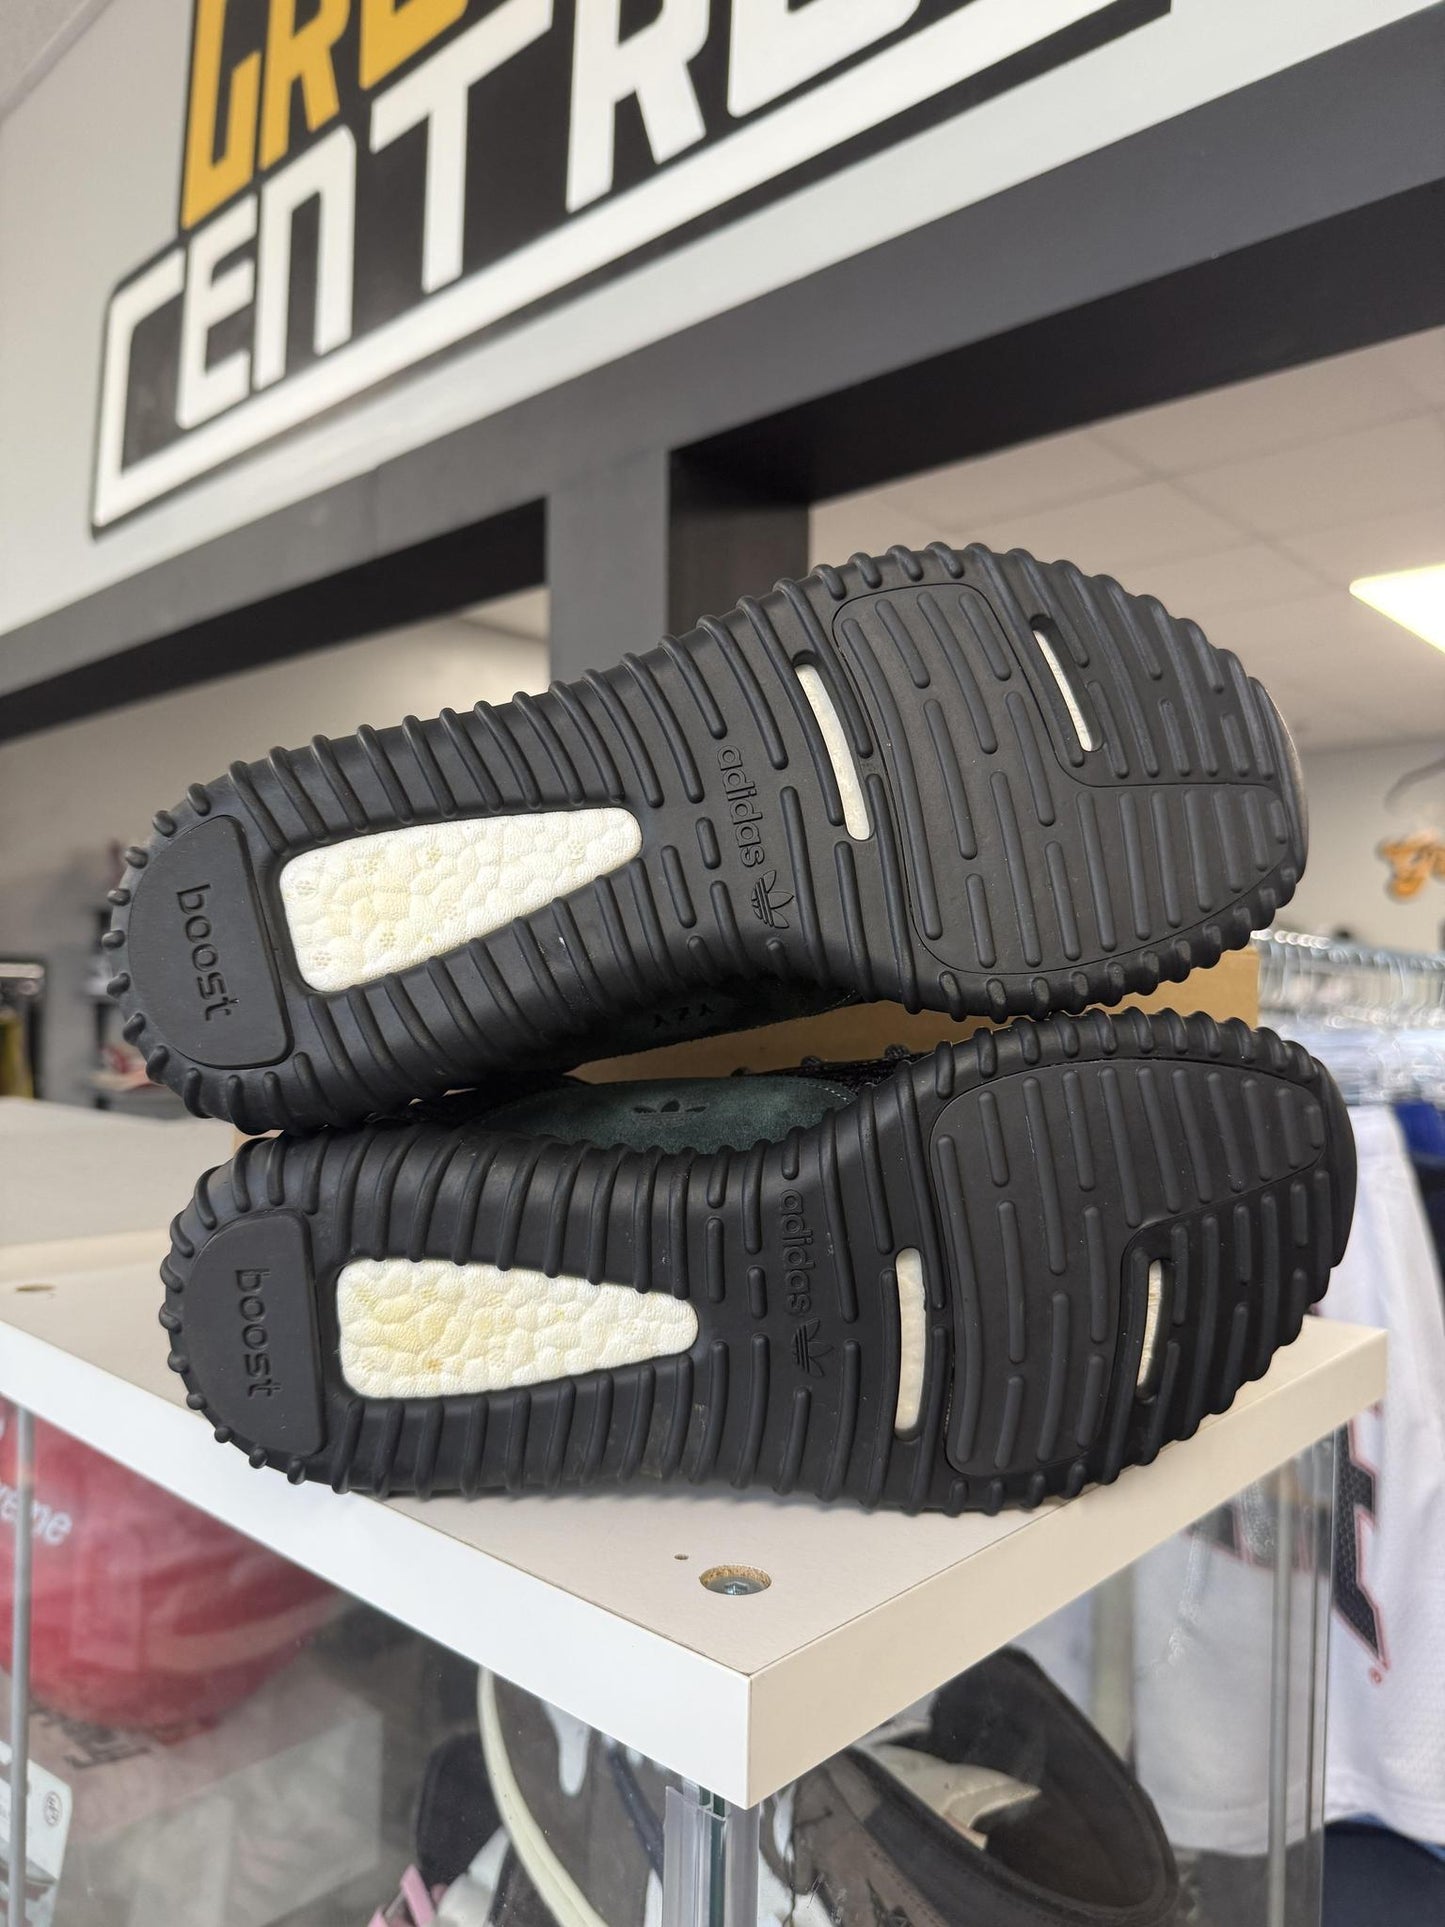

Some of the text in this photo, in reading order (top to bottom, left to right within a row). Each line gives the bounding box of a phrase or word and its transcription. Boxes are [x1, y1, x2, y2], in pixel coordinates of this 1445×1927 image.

[717, 744, 763, 868] adidas
[176, 883, 239, 1021] boost
[779, 1188, 816, 1316] adidas
[235, 1268, 282, 1397] boost
